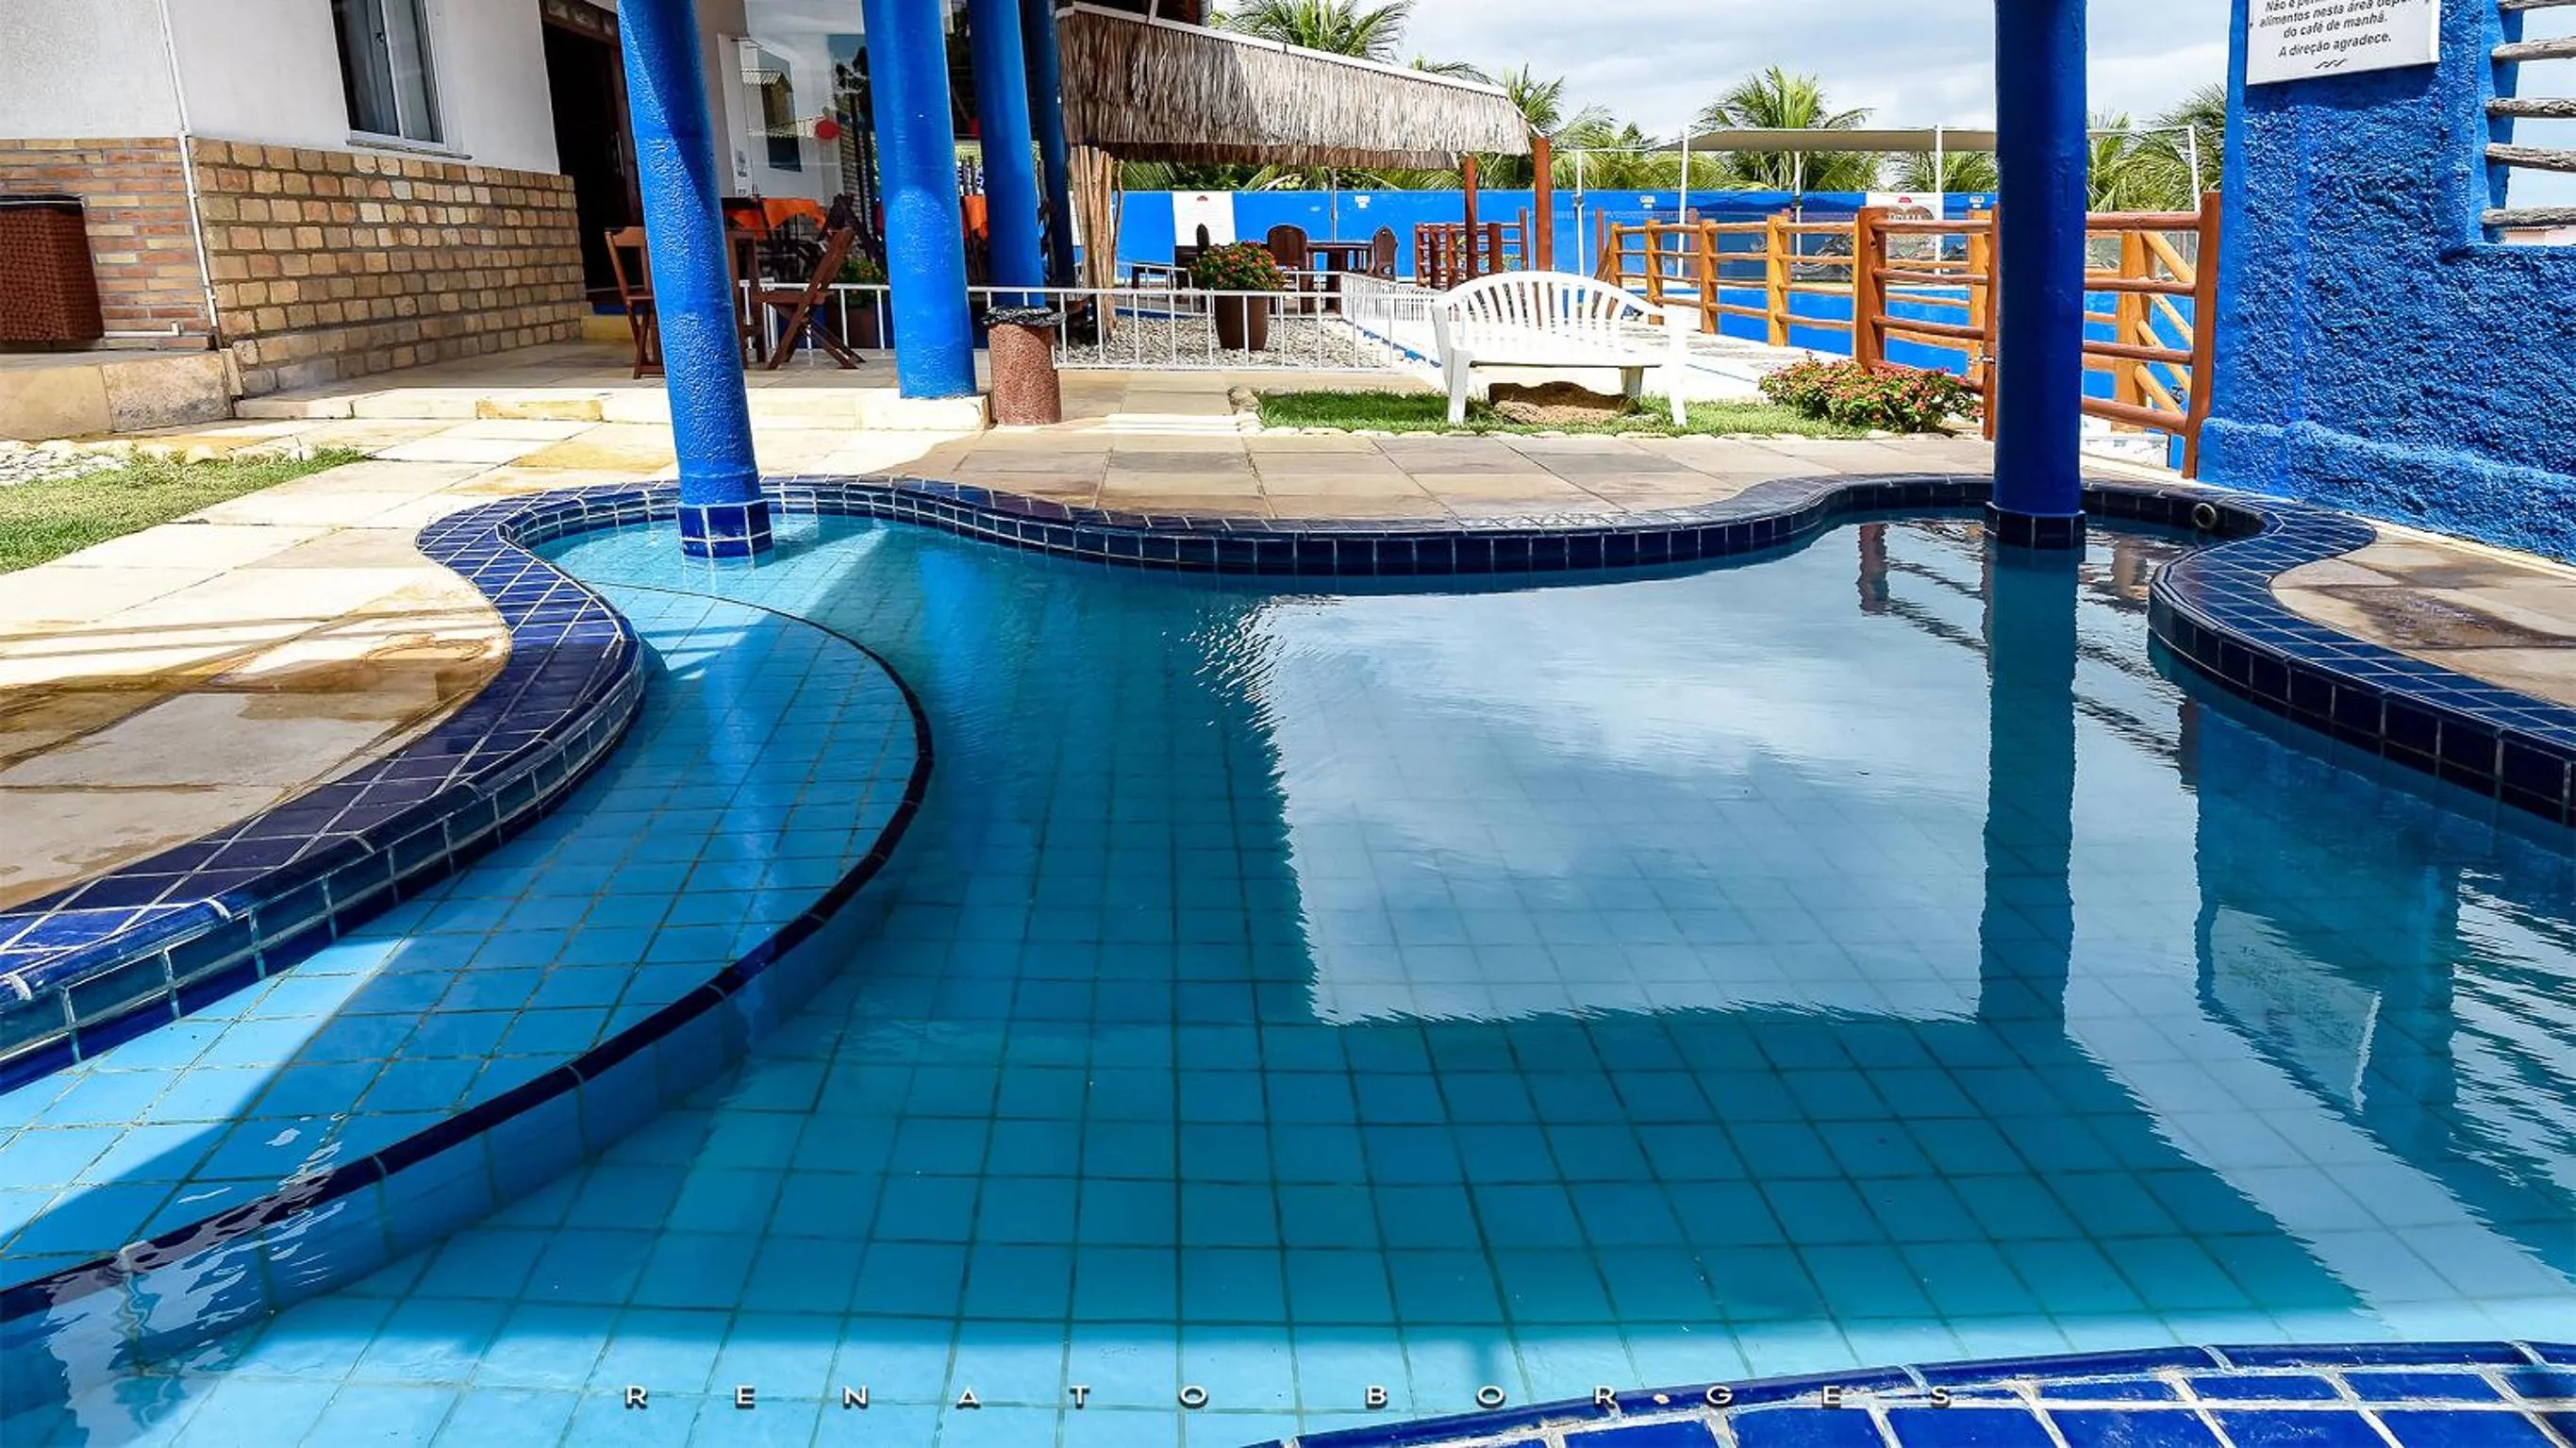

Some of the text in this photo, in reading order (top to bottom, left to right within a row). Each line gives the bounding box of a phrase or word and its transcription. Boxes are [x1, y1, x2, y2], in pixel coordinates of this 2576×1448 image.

[2259, 11, 2311, 27] alimentos
[2313, 5, 2344, 19] nesta
[2284, 9, 2388, 38] do café de manhã.
[2279, 33, 2392, 57] A direção agradece.
